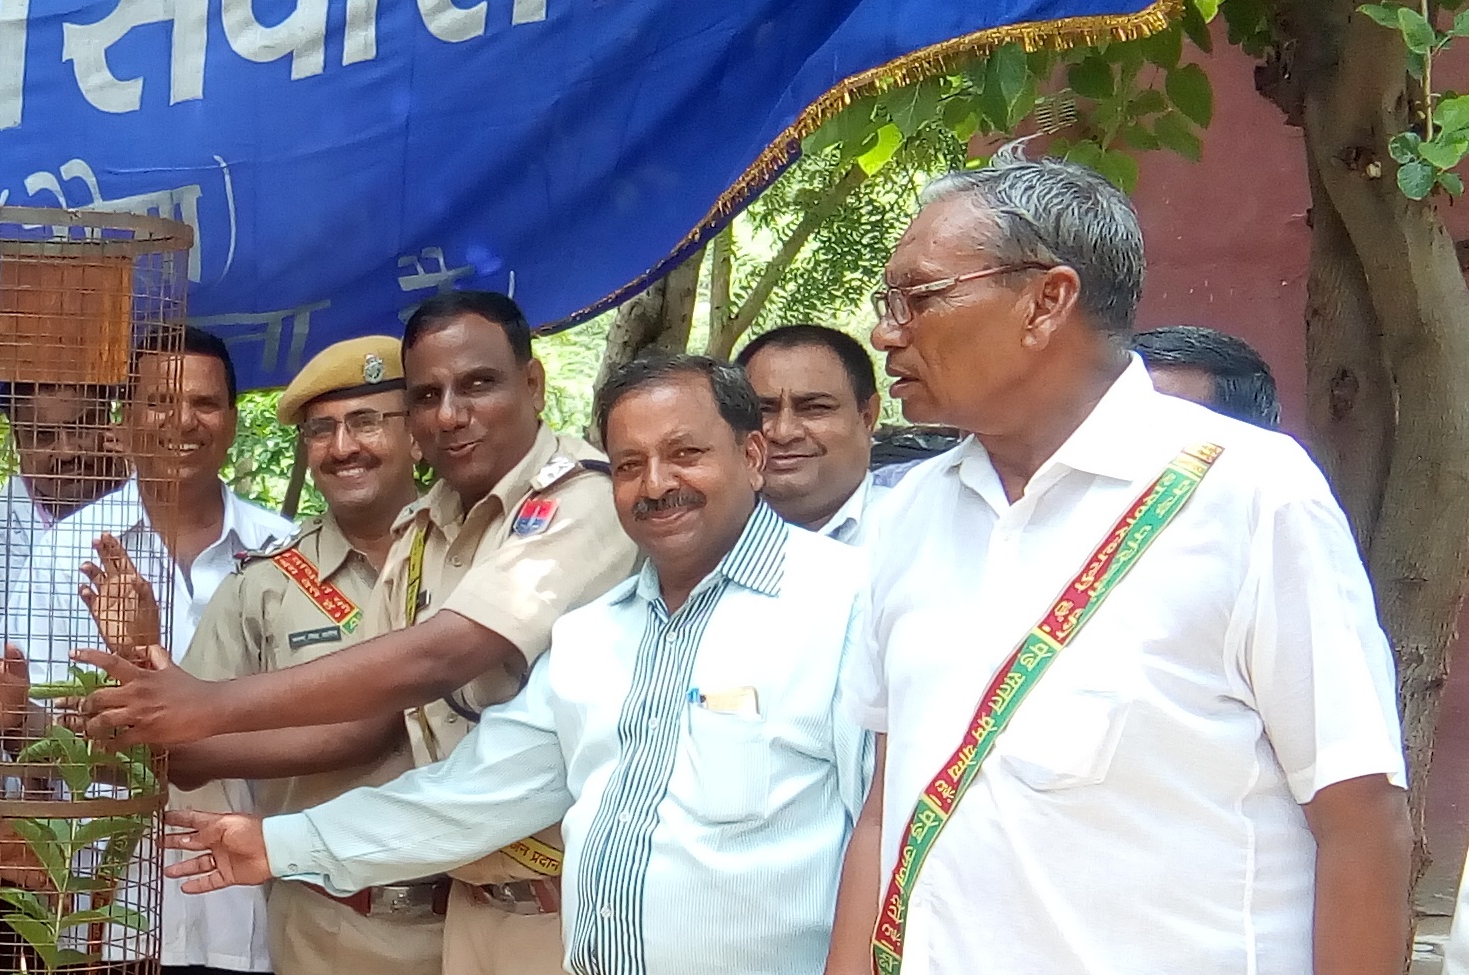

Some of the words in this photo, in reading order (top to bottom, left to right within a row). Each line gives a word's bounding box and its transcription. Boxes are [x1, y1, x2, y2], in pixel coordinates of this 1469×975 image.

[1014, 638, 1053, 674] पेड़
[985, 667, 1026, 716] सतत
[968, 711, 1000, 745] प्रेम
[944, 741, 979, 783] योग्य
[905, 807, 940, 845] पेड़
[530, 851, 560, 871] प्रदान
